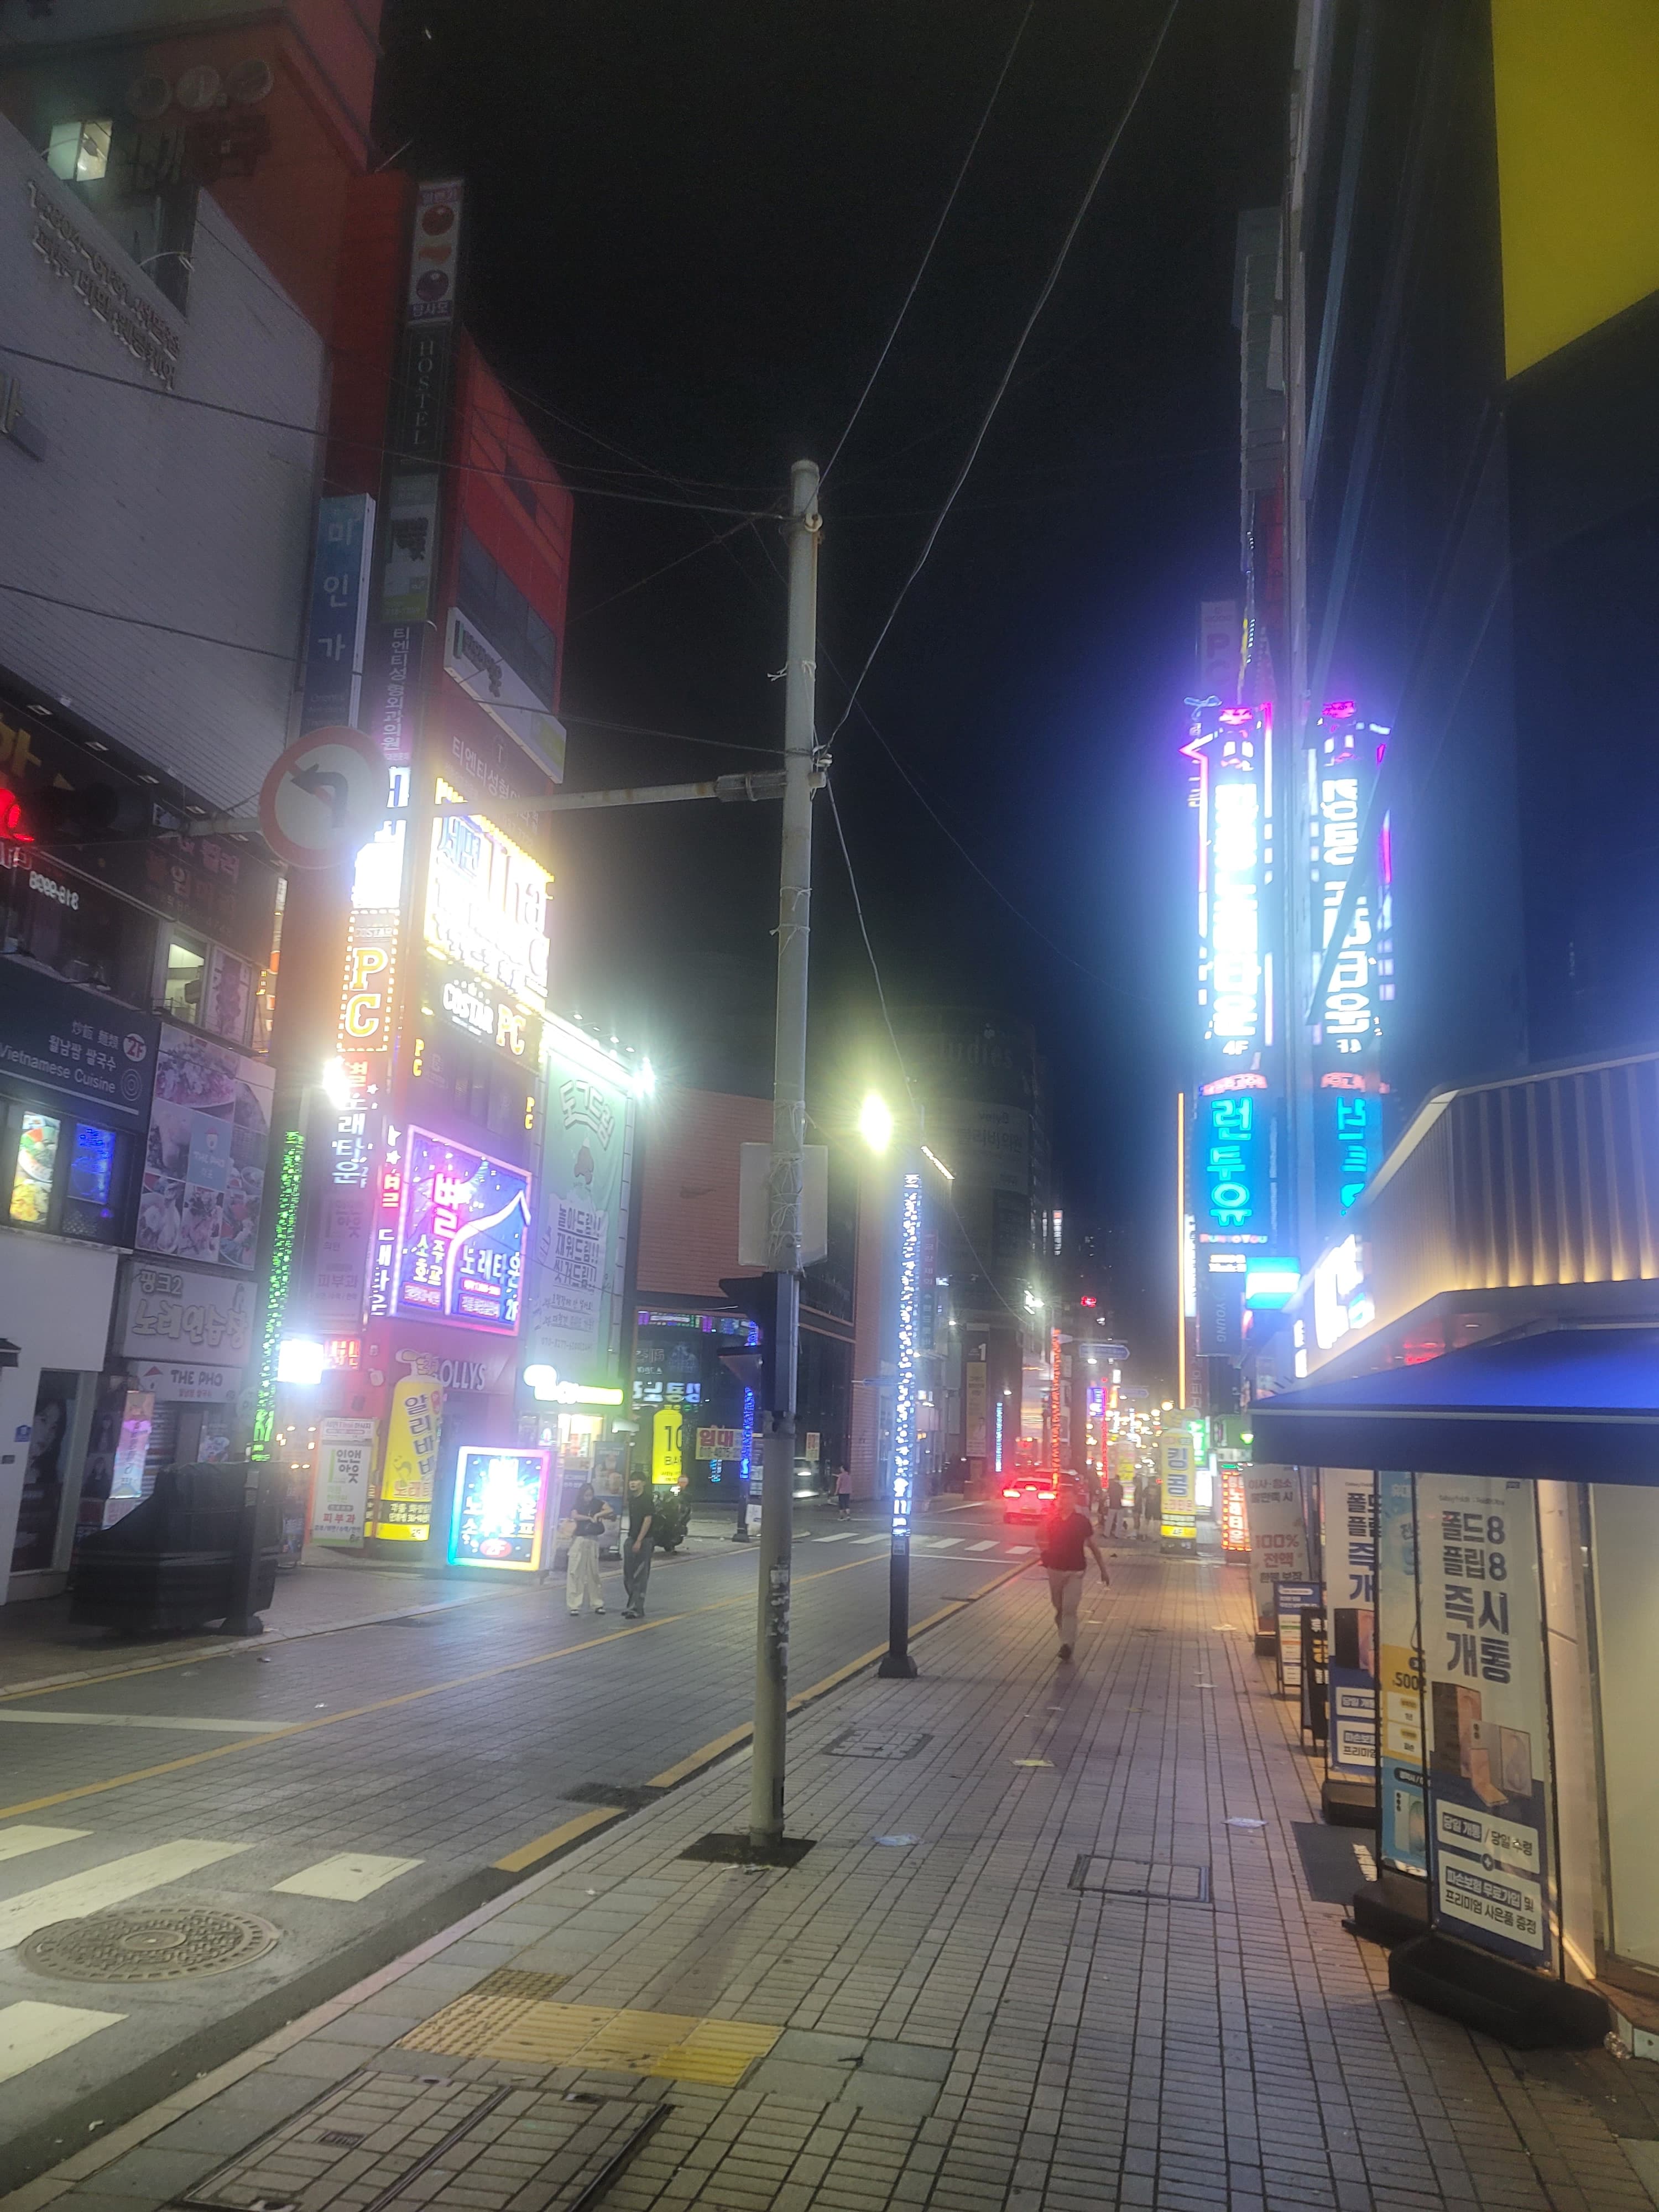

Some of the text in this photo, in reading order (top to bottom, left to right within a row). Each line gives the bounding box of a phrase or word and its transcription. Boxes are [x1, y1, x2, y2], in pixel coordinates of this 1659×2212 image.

[414, 340, 435, 445] HOSTEL
[317, 515, 355, 662] 미인가
[345, 947, 389, 1038] PC
[495, 1003, 526, 1056] PC
[413, 1038, 425, 1077] PC
[1222, 1040, 1249, 1055] 4F
[74, 1068, 116, 1093] Cuisine
[525, 1096, 535, 1130] PC
[1206, 1097, 1253, 1227] 런투야
[415, 1234, 445, 1264] 소주
[413, 1257, 444, 1286] 호프
[1216, 1297, 1227, 1343] YOUNG
[170, 1369, 194, 1384] THE
[431, 1360, 488, 1391] OLLYS
[338, 1465, 360, 1484] 아웃
[1282, 1491, 1293, 1502] 시
[322, 1513, 356, 1524] 피부과
[1441, 1510, 1506, 1545] 폴드8
[1255, 1533, 1299, 1549] 100%
[1264, 1551, 1293, 1568] 전액
[1442, 1546, 1507, 1581] 플립8
[1444, 1584, 1510, 1636] 즉시
[1447, 1632, 1511, 1684] 개통
[1443, 1815, 1462, 1834] 당일
[1462, 1820, 1481, 1839] 개통
[1491, 1830, 1510, 1850] 당일
[1446, 1868, 1483, 1894] 파손보험
[1483, 1881, 1521, 1910] 무료가입
[1445, 1889, 1537, 1936] 프리미엄 사은품 증정
